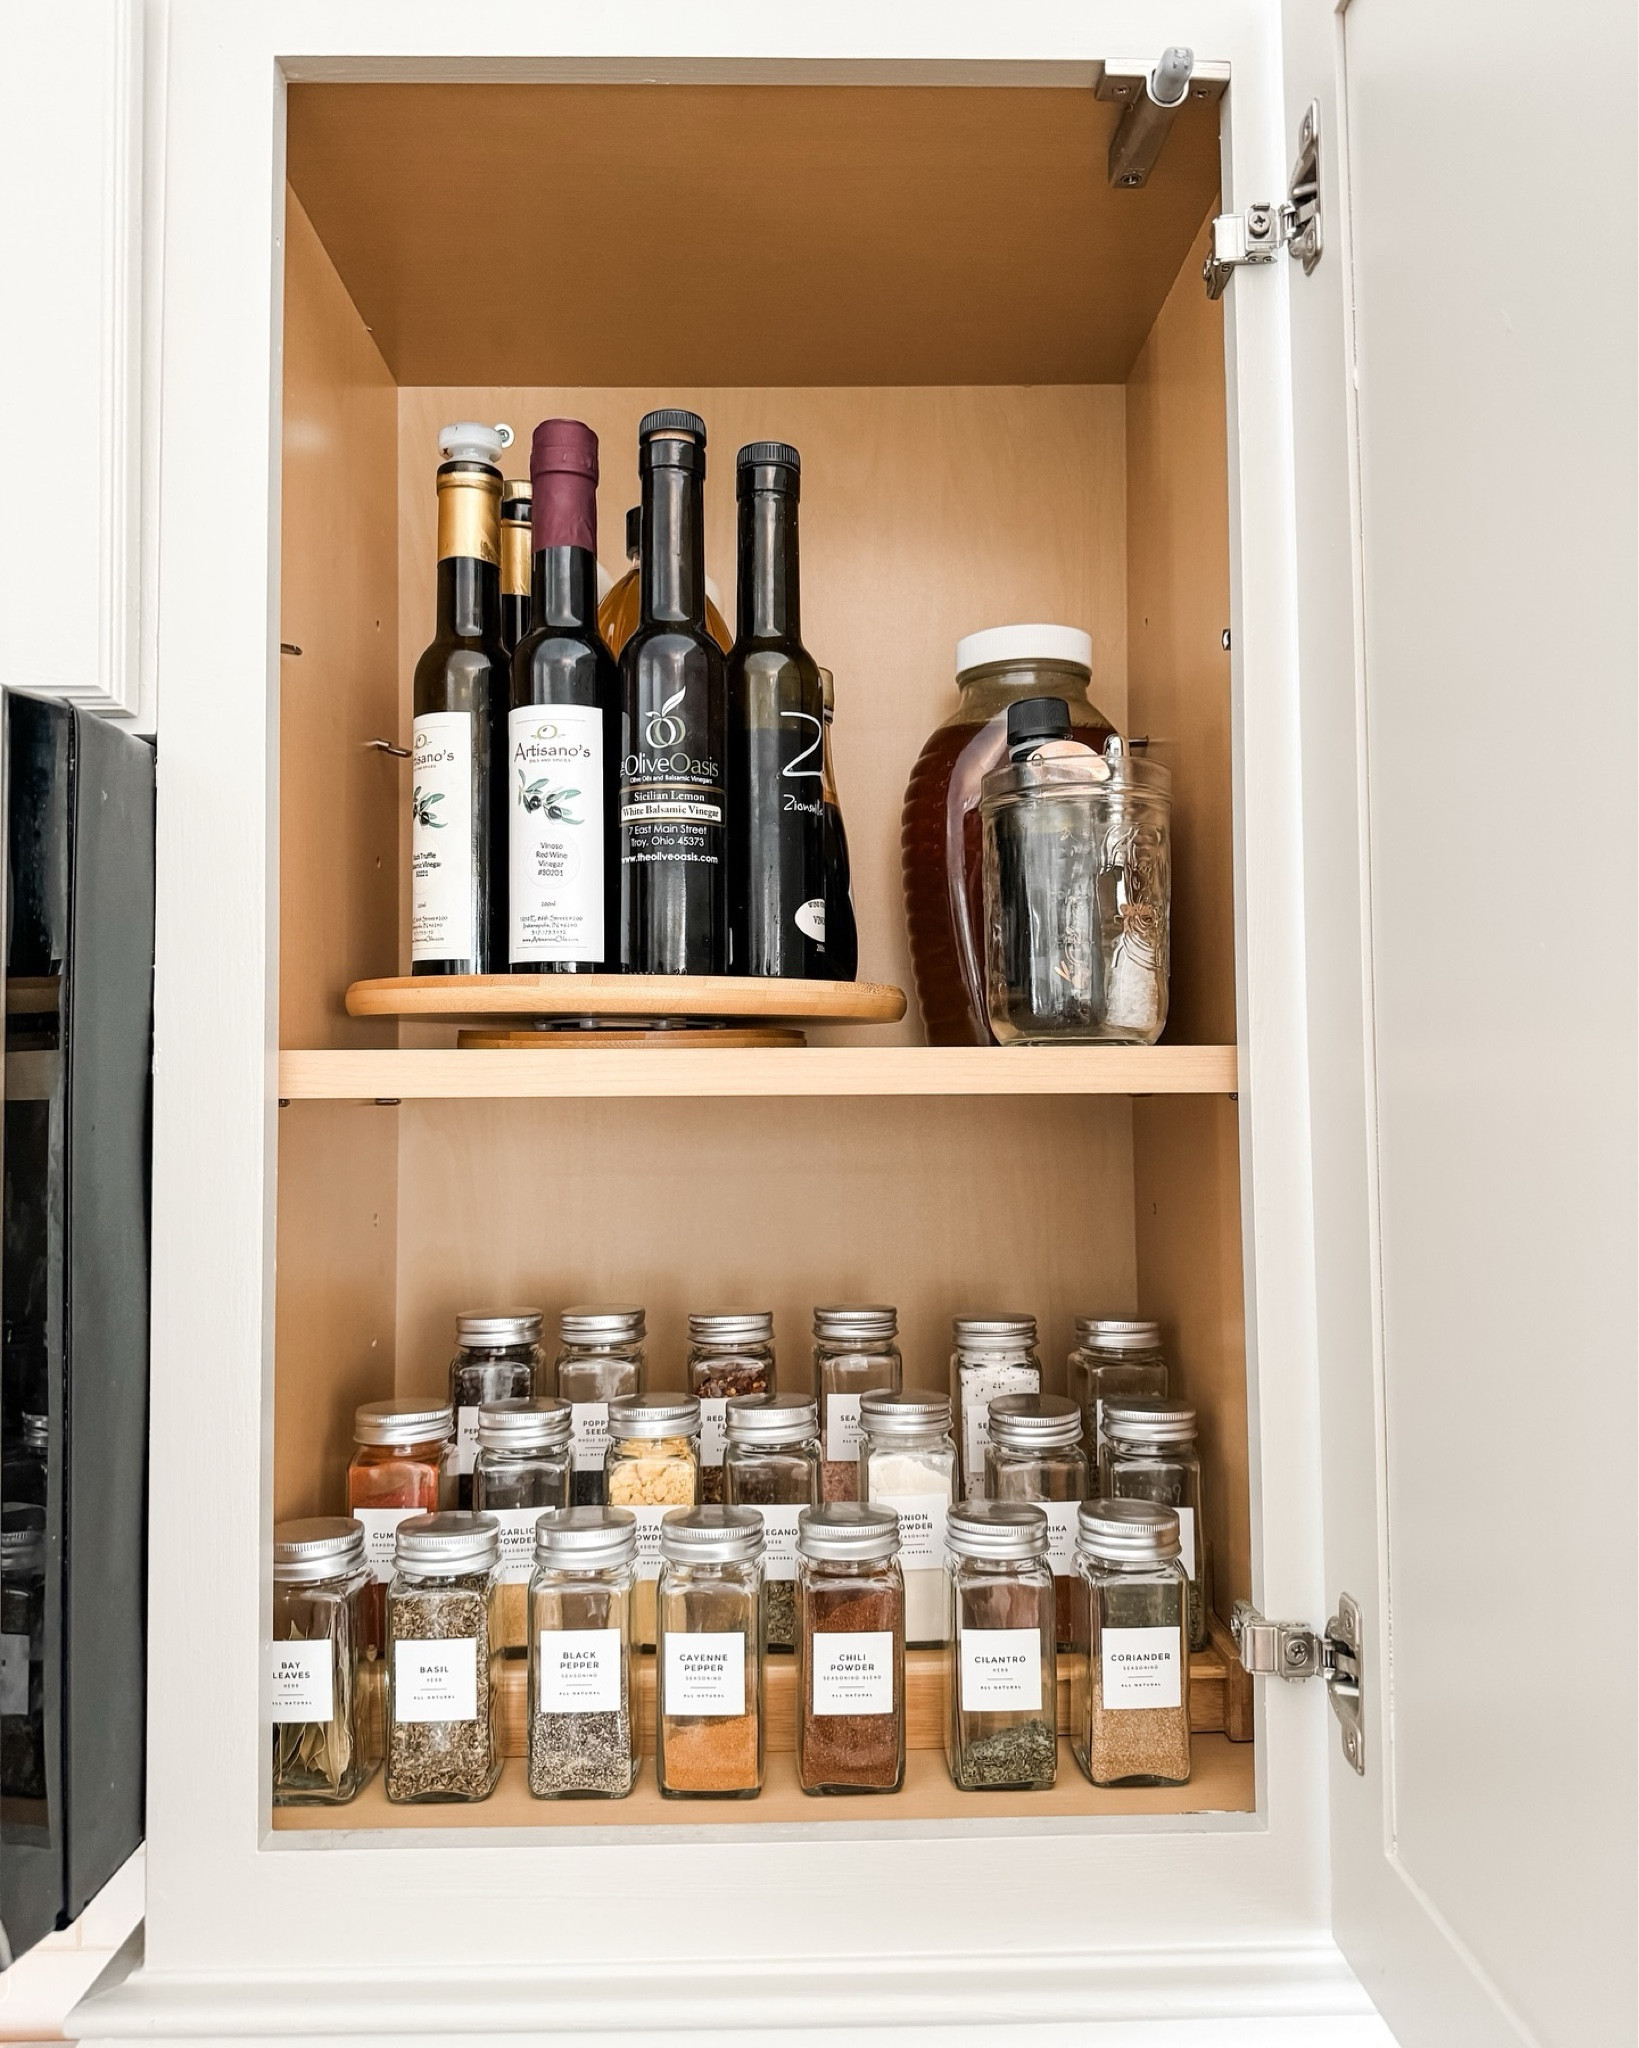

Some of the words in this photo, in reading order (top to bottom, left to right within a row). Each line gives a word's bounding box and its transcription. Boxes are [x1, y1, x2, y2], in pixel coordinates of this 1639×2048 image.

[514, 742, 591, 763] Artisano's
[665, 774, 690, 782] Balsamic
[691, 776, 713, 784] Vinegars
[634, 790, 669, 802] Sicilian
[671, 790, 705, 802] Lemon
[623, 807, 644, 817] White
[645, 804, 687, 815] Balsamic
[688, 805, 719, 818] Vinegar
[629, 826, 633, 835] 7
[634, 825, 652, 835] East
[653, 824, 678, 834] Main
[680, 824, 707, 835] Street
[540, 841, 564, 850] Vinoso
[631, 838, 649, 848] Troy,
[651, 835, 675, 846] Ohio
[677, 836, 704, 847] 45373
[536, 851, 549, 859] Red
[549, 851, 568, 859] Wine
[537, 860, 564, 869] Vinegar
[706, 1415, 724, 1423] RED
[500, 1527, 535, 1536] GARLIC
[765, 1528, 798, 1536] EGANO
[562, 1651, 596, 1659] BLACK
[679, 1653, 728, 1662] CAYENNE
[839, 1653, 866, 1661] CHILI
[974, 1655, 1026, 1663] CILANTRO
[1110, 1653, 1171, 1661] CORIANDER
[281, 1661, 301, 1669] BAY
[560, 1661, 600, 1669] PEPPER
[684, 1664, 724, 1672] PEPPER
[830, 1663, 875, 1671] POWDER
[419, 1666, 449, 1674] BASIL
[272, 1671, 311, 1679] LEAVES
